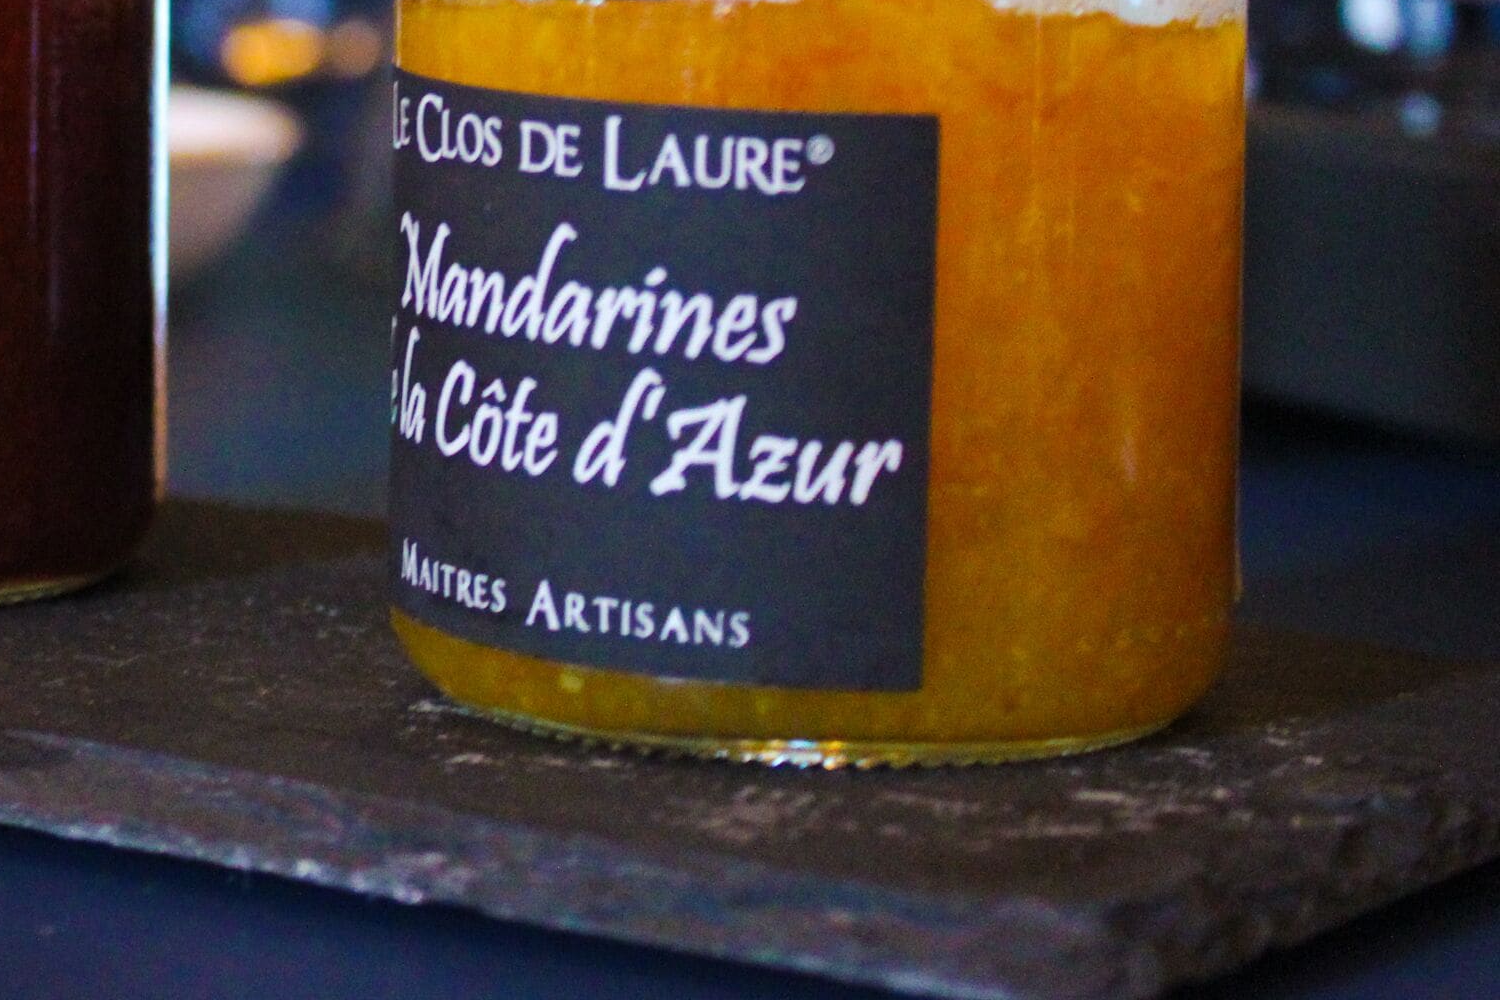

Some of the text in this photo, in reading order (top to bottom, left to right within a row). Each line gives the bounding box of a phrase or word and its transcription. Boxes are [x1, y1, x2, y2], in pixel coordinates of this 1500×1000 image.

[417, 94, 504, 168] CLOS
[520, 121, 584, 179] DE
[401, 212, 797, 364] Mandarines
[400, 327, 428, 445] la
[436, 360, 559, 478] Côte
[573, 367, 904, 506] d'Azur
[526, 580, 751, 649] ARTISANS
